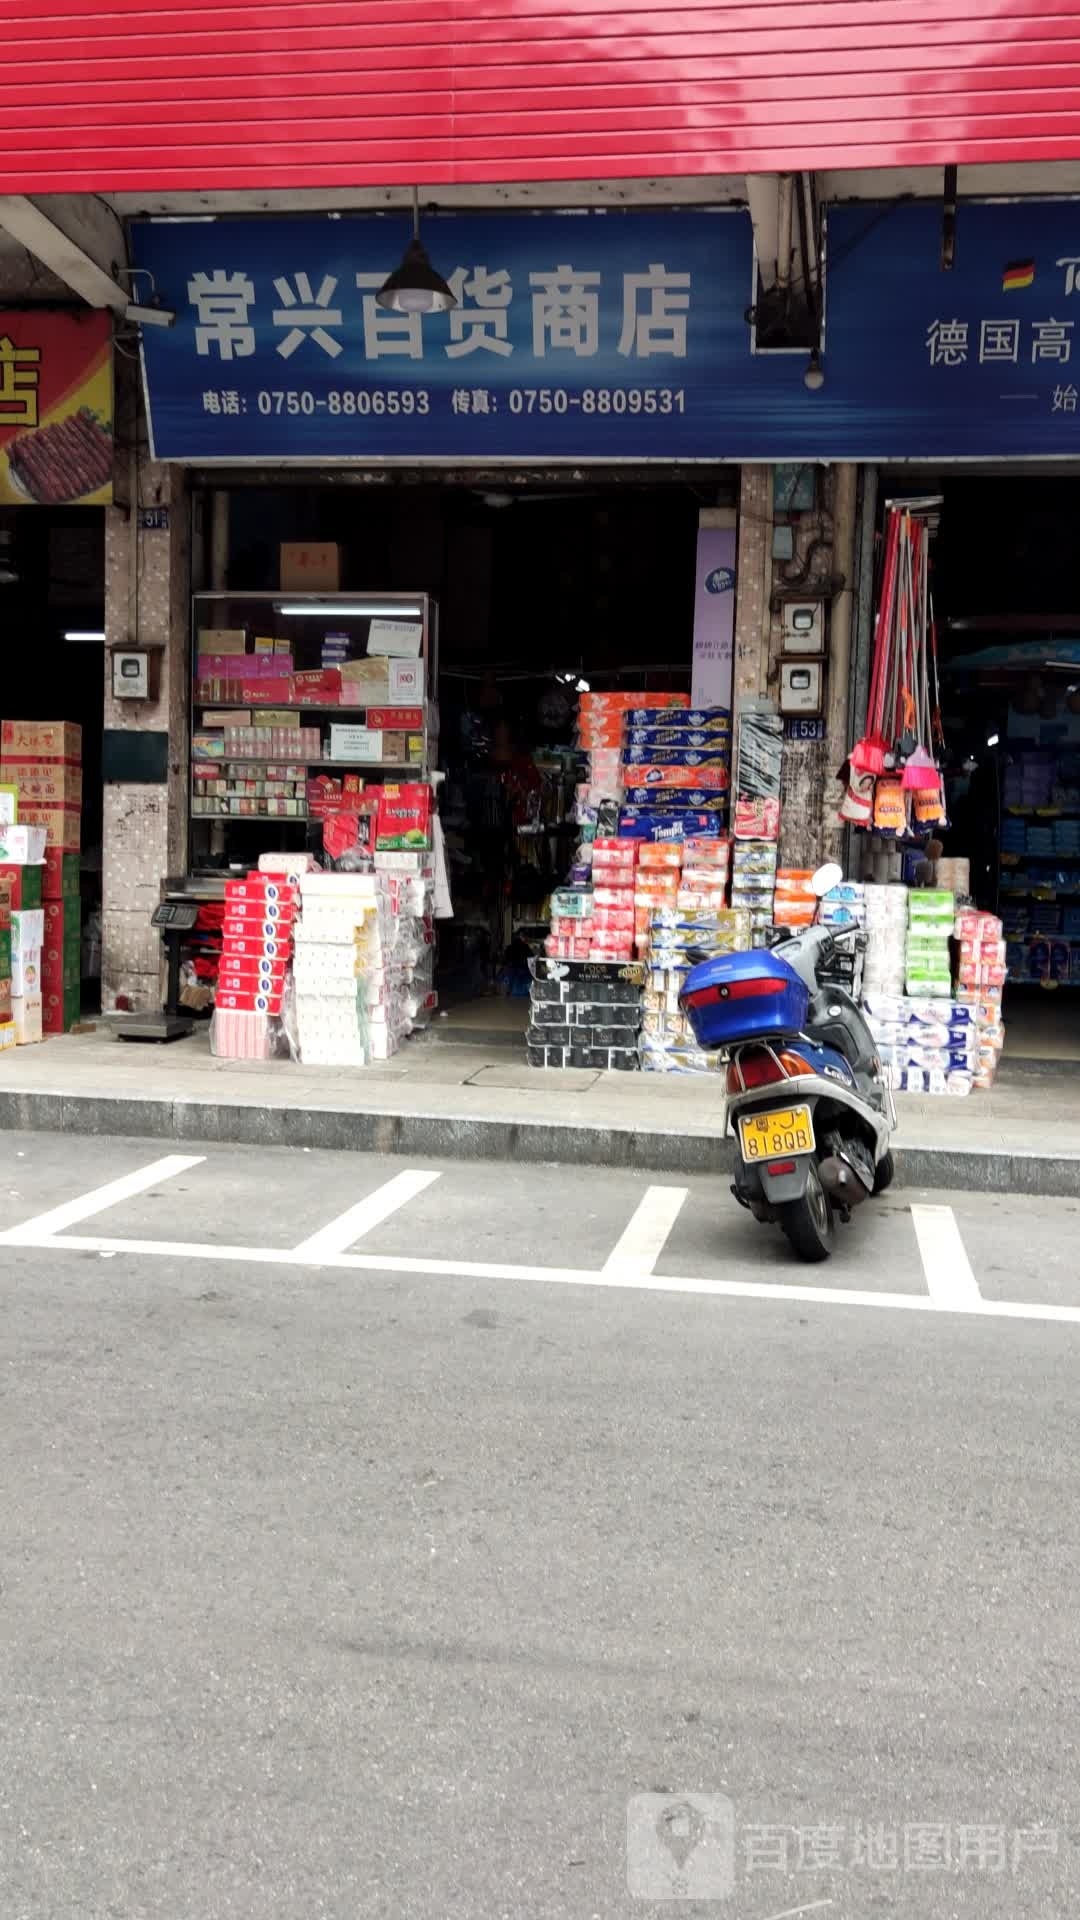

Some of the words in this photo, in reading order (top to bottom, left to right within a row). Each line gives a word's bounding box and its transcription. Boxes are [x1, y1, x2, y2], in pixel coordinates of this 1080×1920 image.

[187, 264, 692, 360] 常兴百货商店
[925, 317, 1074, 366] 德国高
[748, 1129, 807, 1156] 818QB
